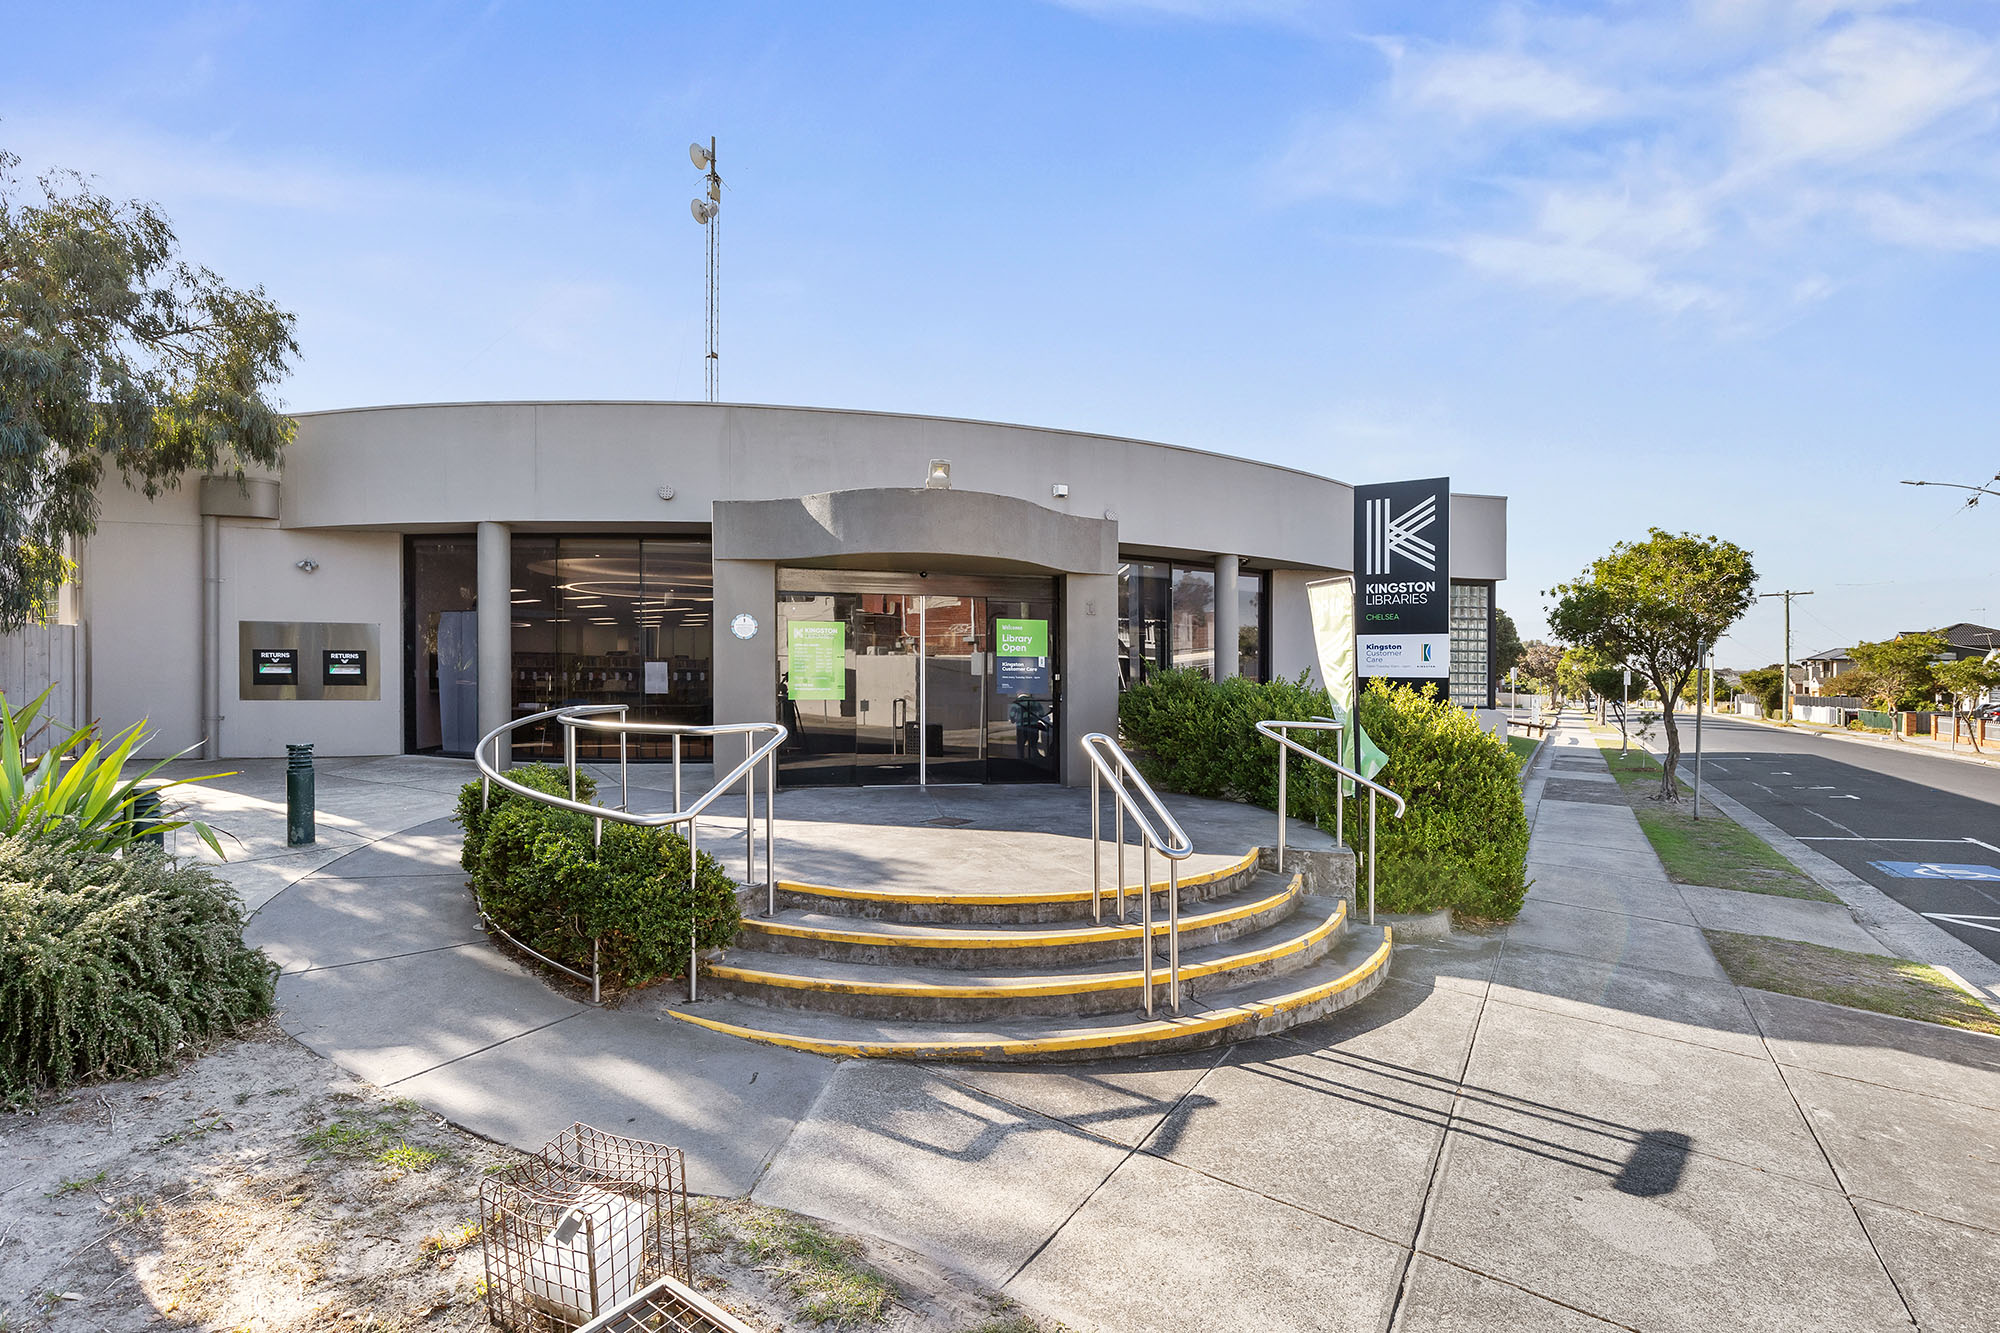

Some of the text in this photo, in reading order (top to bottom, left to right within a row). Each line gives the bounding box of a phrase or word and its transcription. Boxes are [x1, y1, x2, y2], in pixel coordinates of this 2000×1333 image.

[1366, 581, 1436, 594] KINGSTON
[1366, 593, 1428, 606] LIBRARIES
[1366, 613, 1399, 621] CHELSEA
[1002, 634, 1032, 645] Library
[1002, 643, 1026, 653] Open
[1366, 643, 1402, 651] Kingston
